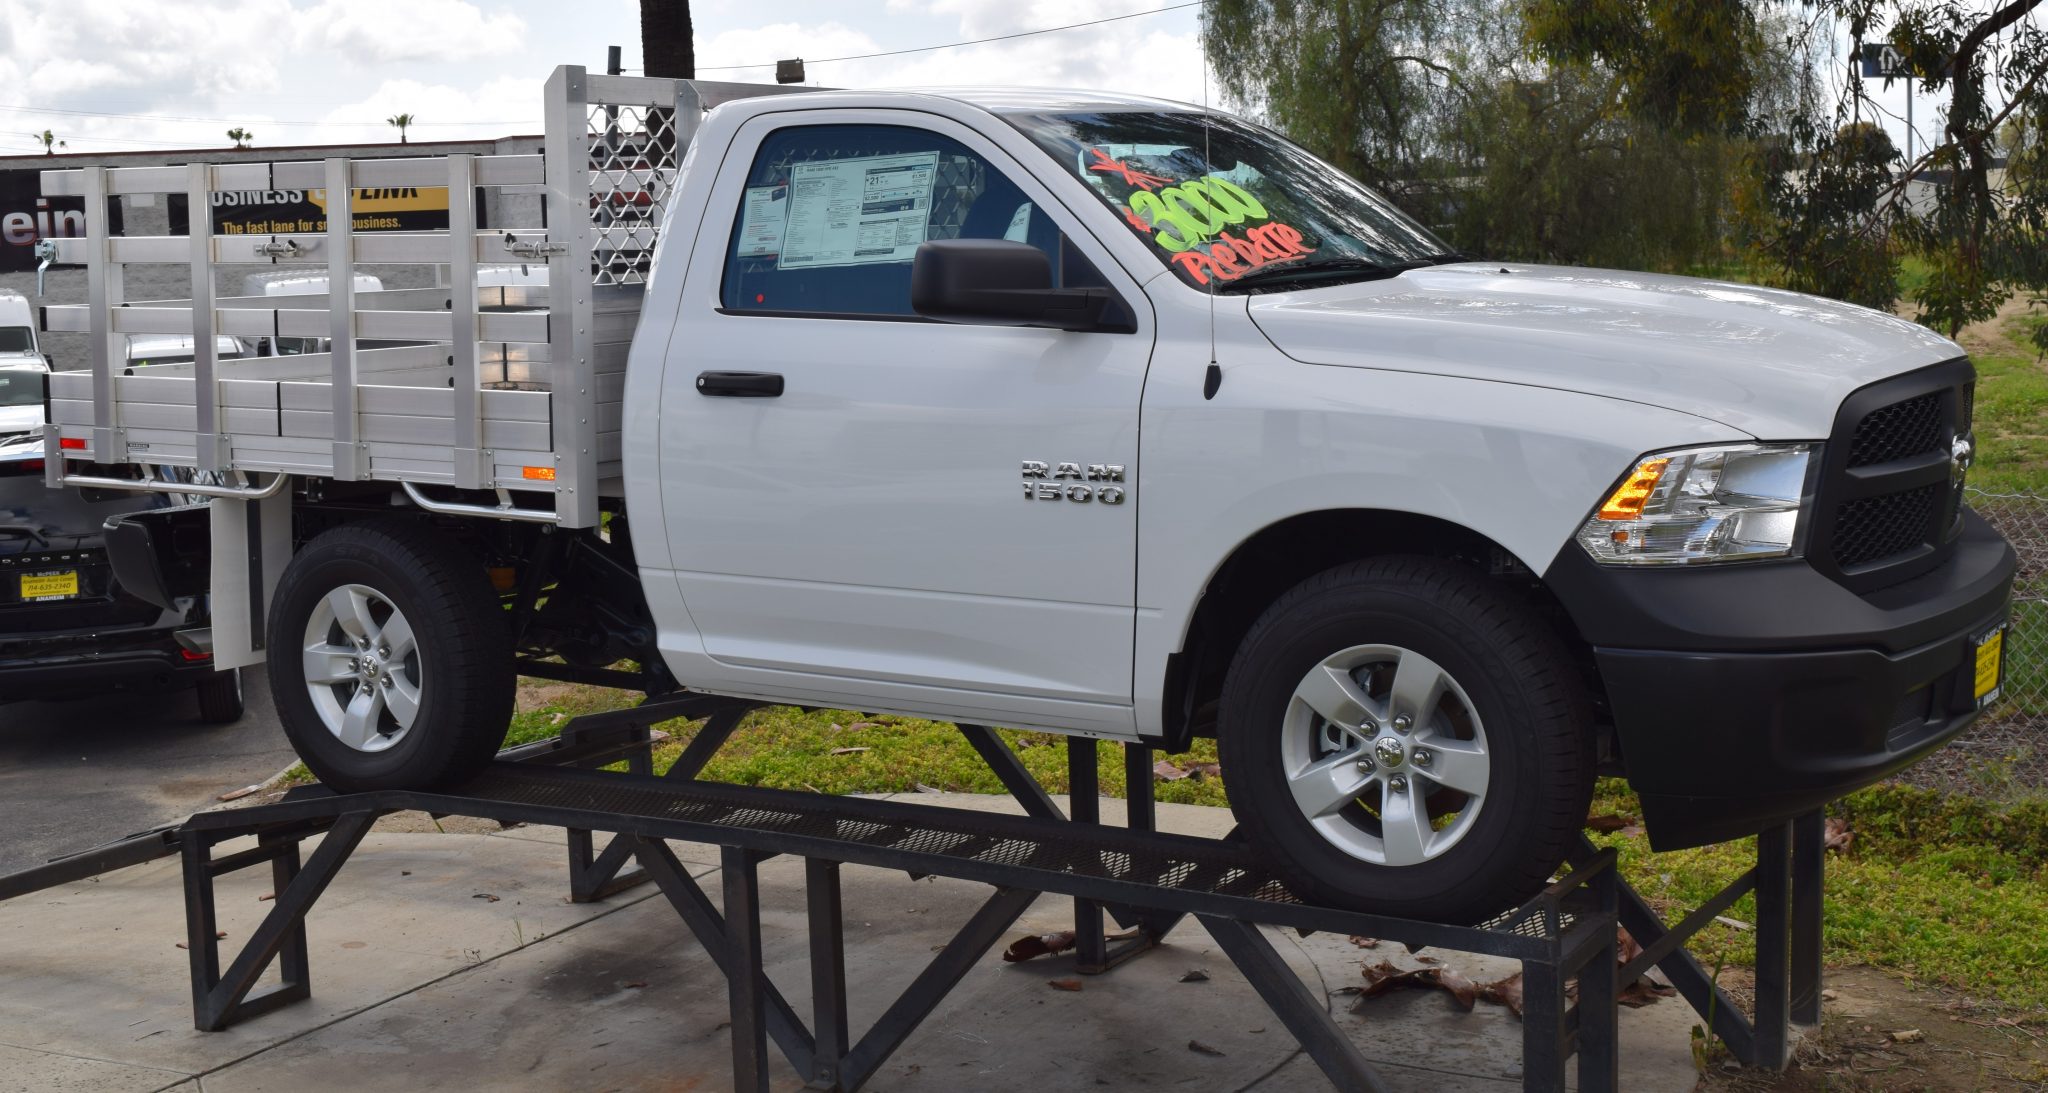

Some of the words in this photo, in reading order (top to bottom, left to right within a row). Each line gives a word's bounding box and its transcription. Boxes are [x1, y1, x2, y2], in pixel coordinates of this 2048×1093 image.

[212, 189, 303, 207] USINESS
[1128, 176, 1268, 252] 3000
[222, 222, 244, 235] The
[246, 221, 269, 234] fast
[271, 220, 295, 233] lane
[298, 219, 313, 232] for
[1021, 460, 1125, 482] RAM
[1022, 481, 1125, 506] 1500
[2, 553, 89, 564] DODGE
[35, 594, 65, 602] ANAHEIM
